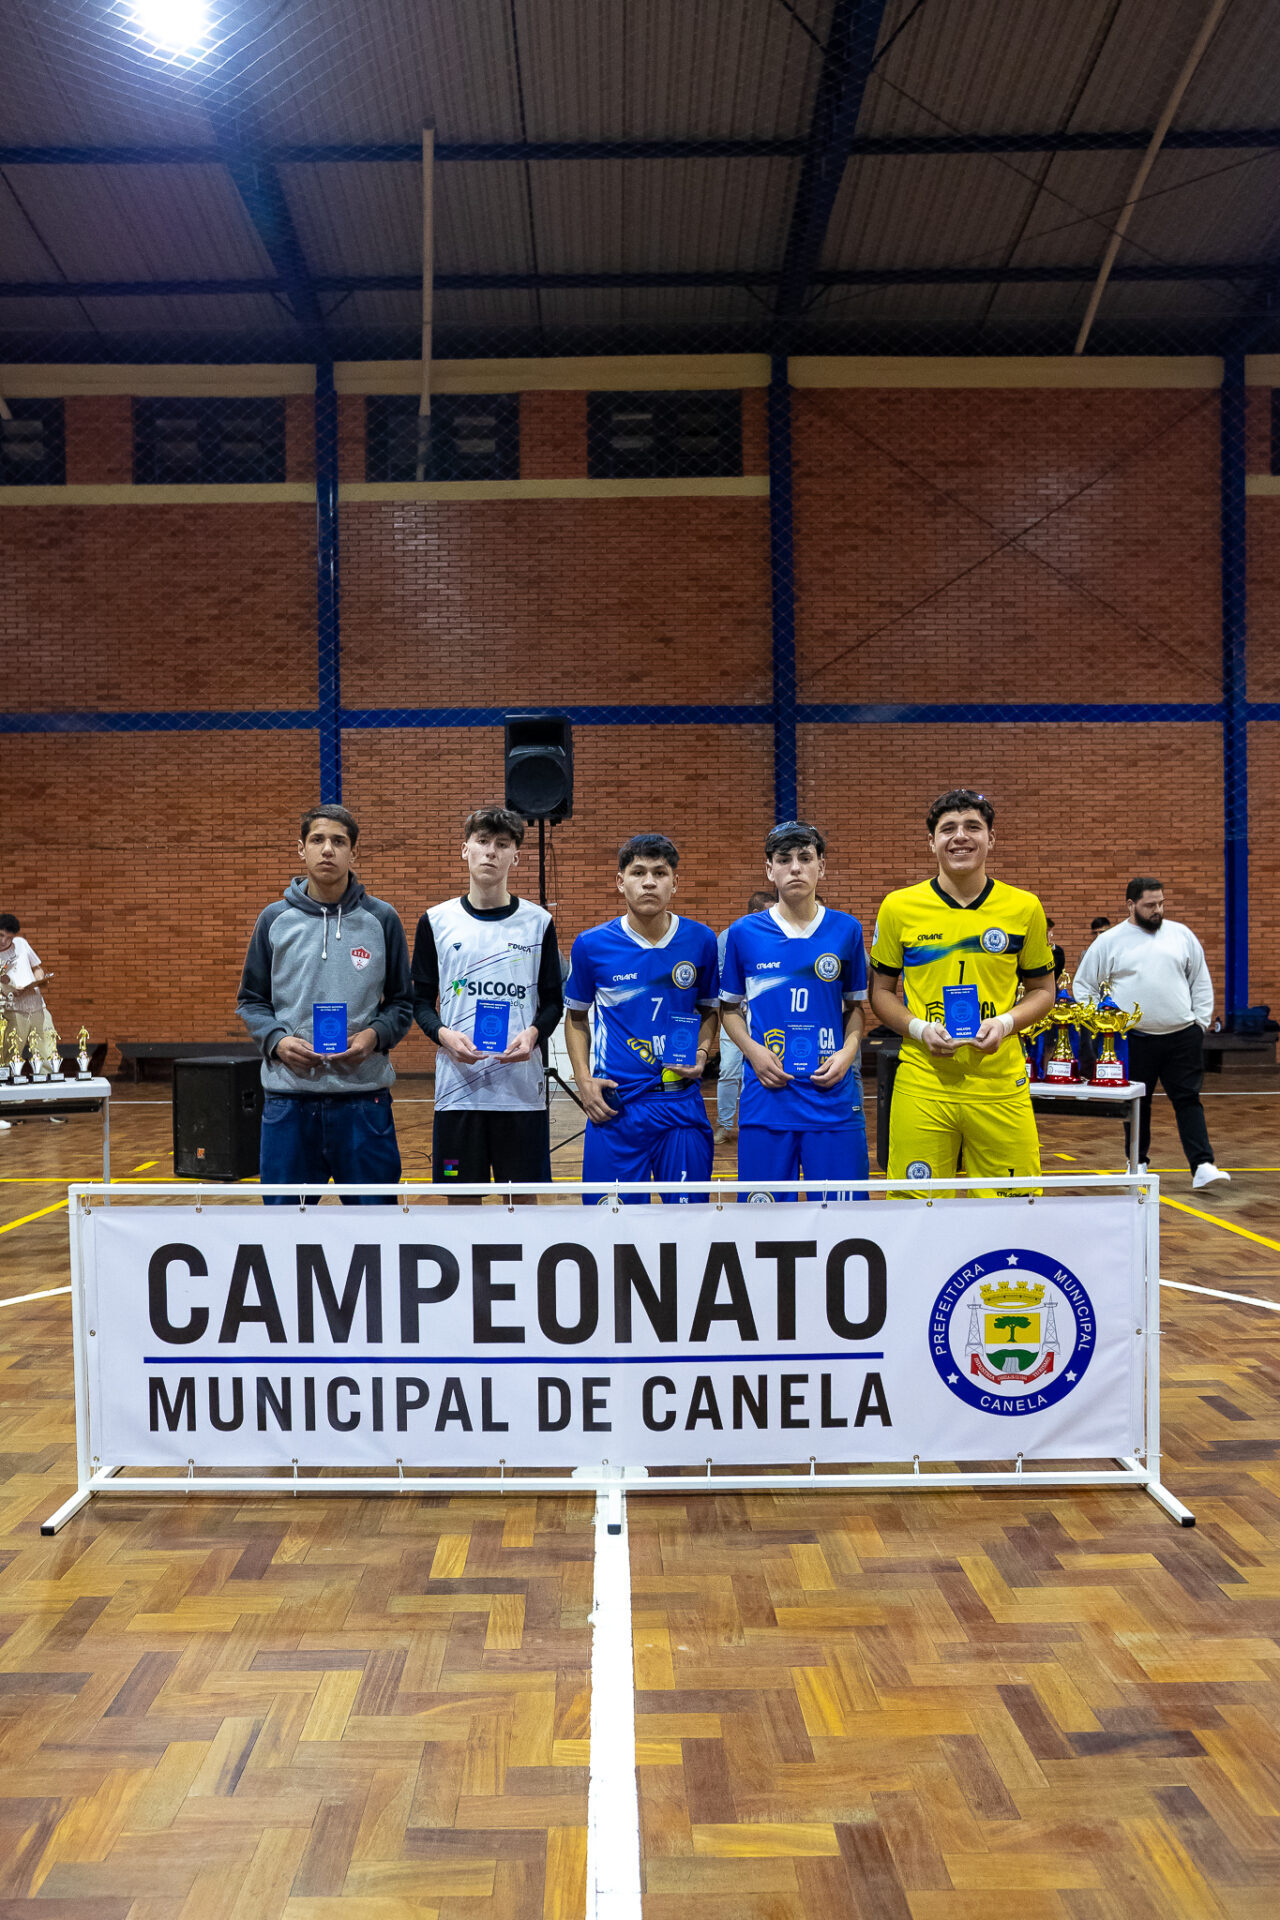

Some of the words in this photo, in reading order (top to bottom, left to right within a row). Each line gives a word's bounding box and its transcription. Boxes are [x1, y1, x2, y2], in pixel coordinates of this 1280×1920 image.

[958, 960, 965, 984] 1
[467, 981, 526, 999] SICOOB
[790, 987, 809, 1013] 10
[651, 997, 663, 1022] 7
[147, 1238, 888, 1345] CAMPEONATO
[933, 1263, 985, 1355] PREFEITURA
[1053, 1269, 1092, 1352] MUNICIPAL
[149, 1375, 509, 1432] MUNICIPAL
[538, 1375, 612, 1432] DE
[642, 1371, 893, 1430] CANELA
[980, 1394, 1048, 1412] CANELA
